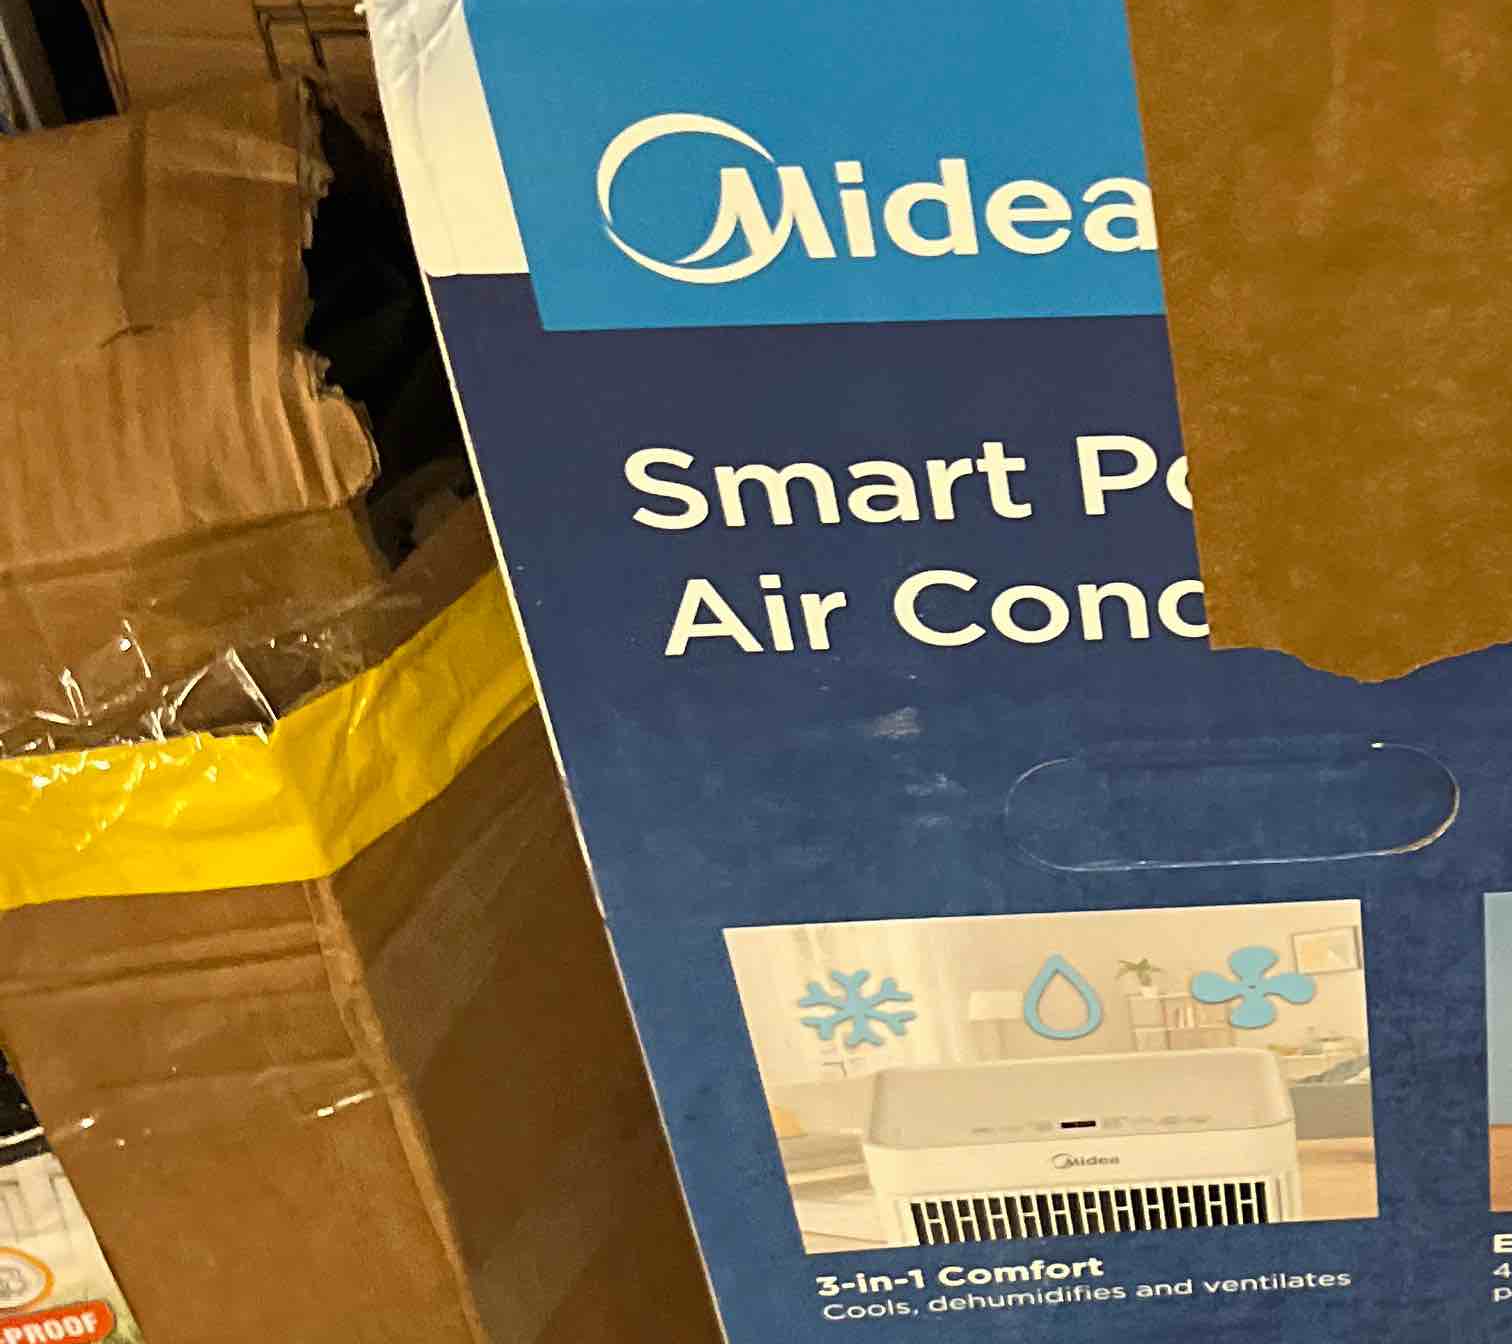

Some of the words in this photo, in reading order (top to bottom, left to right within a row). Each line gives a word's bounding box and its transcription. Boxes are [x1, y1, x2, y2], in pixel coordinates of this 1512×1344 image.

[596, 112, 1159, 285] Midea
[623, 440, 1034, 531] Smart
[664, 573, 848, 657] Air
[815, 1267, 926, 1299] 3-in-1
[937, 1255, 1105, 1291] Comfort
[822, 1296, 920, 1323] Cools,
[927, 1281, 1127, 1316] dehumidifies
[1135, 1277, 1194, 1300] and
[1204, 1269, 1352, 1296] ventilates
[1492, 1258, 1512, 1279] 4
